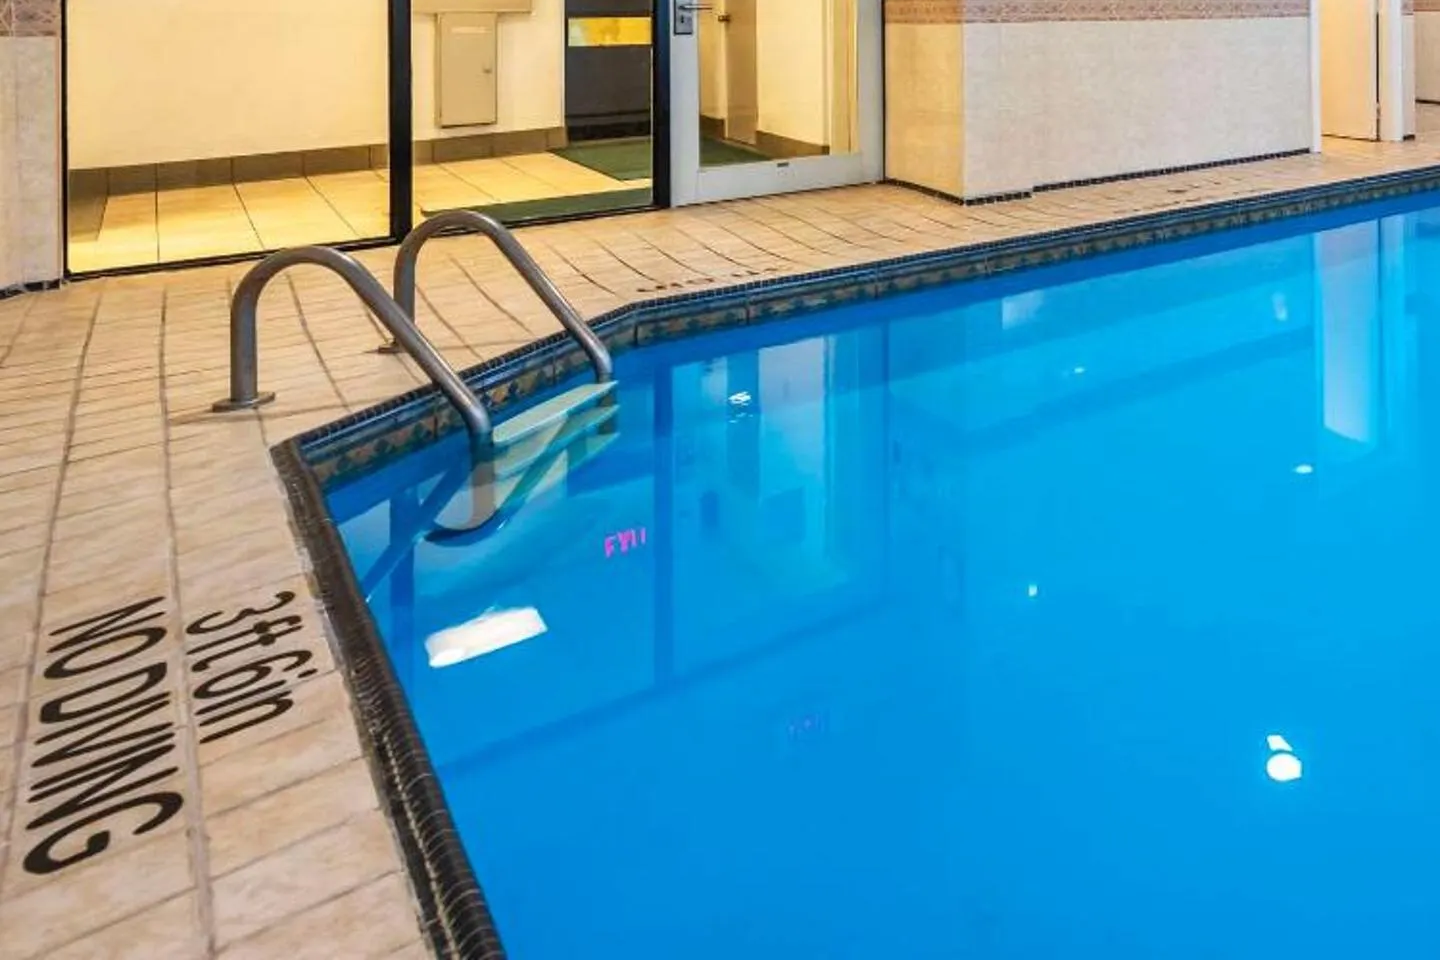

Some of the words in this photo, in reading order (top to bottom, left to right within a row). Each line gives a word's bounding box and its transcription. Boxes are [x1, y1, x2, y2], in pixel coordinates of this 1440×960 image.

[43, 595, 168, 679] NO
[185, 590, 304, 673] 3ft
[193, 649, 318, 746] 6in
[22, 661, 184, 875] DIVING
